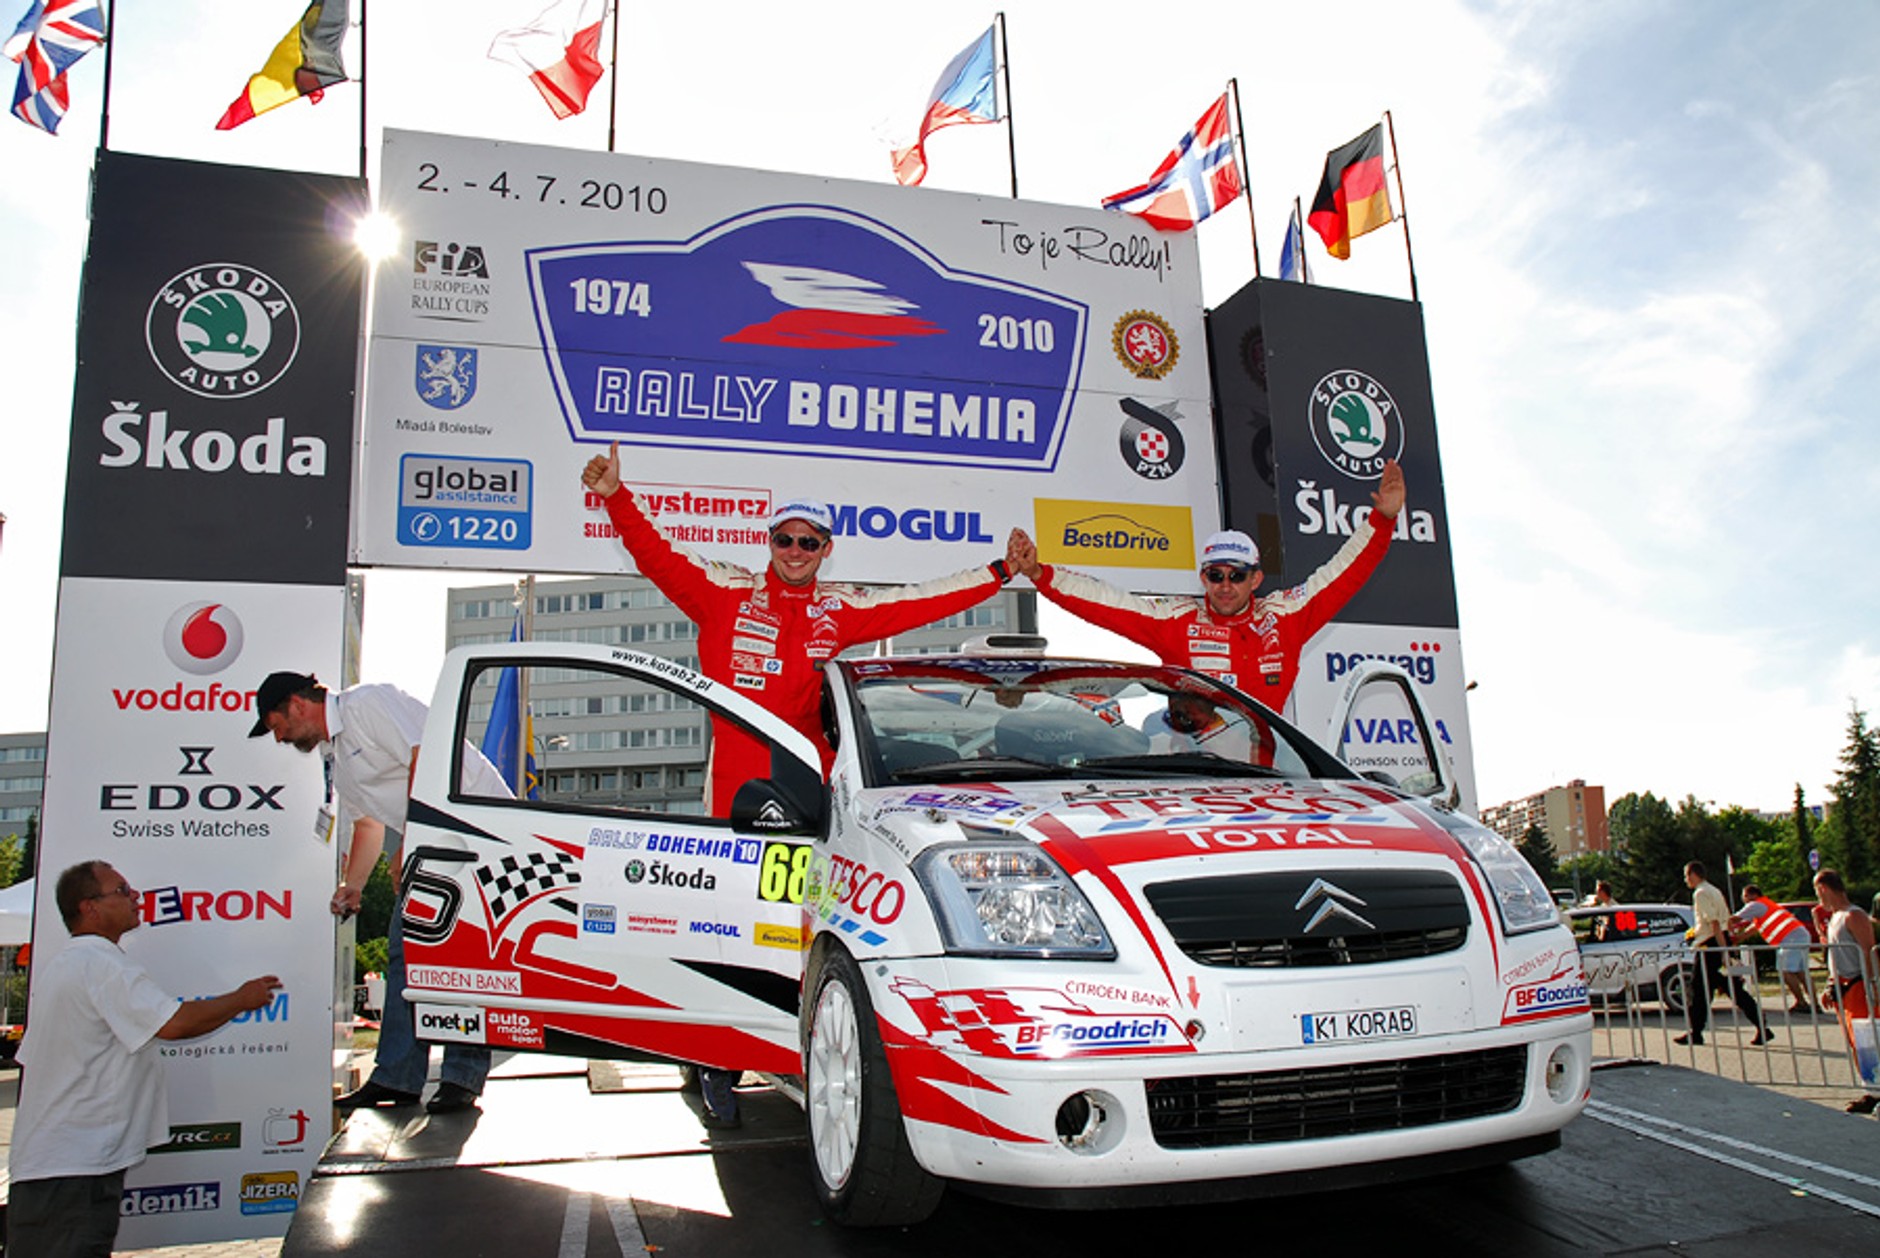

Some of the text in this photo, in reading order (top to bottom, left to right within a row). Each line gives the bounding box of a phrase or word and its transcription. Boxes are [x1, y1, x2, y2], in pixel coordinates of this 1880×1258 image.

[417, 163, 449, 193] 2.
[488, 171, 520, 200] 4.
[536, 174, 566, 204] 7.
[580, 180, 668, 215] 2010
[981, 219, 1172, 283] To je Rally!
[413, 279, 490, 296] EUROPEAN
[570, 277, 651, 318] 1974
[411, 295, 489, 315] RALLY CUPS
[978, 313, 1055, 353] 2010
[179, 366, 261, 392] AUTO
[595, 366, 1037, 444] RALLY BOHEMIA
[100, 401, 327, 478] Škoda
[395, 418, 493, 436] Mladá Boleslav
[1136, 460, 1173, 479] PZM
[1335, 452, 1385, 474] AUTO
[415, 466, 517, 500] global
[436, 490, 518, 505] assistance
[448, 516, 518, 542] 1220
[825, 503, 994, 544] MOGUL
[1063, 528, 1170, 552] BestDrive
[112, 681, 259, 712] vodafon
[1349, 756, 1399, 767] JOHNSON
[100, 784, 286, 811] EDOX
[1067, 794, 1374, 820] TESCO
[112, 819, 270, 838] Swiss Watches
[1168, 827, 1374, 850] TOTAL
[588, 827, 646, 847] RALLY
[646, 834, 733, 858] BOHEMIA
[648, 860, 717, 890] Škoda
[759, 843, 812, 904] 68
[831, 853, 906, 925] TESCO
[689, 920, 742, 938] MOGUL
[476, 973, 519, 992] BANK
[1131, 991, 1172, 1009] BANK
[421, 1012, 480, 1035] onet.pl
[489, 1012, 531, 1027] auto
[497, 1025, 539, 1035] motor
[1016, 1018, 1168, 1045] BFGoodrich
[1315, 1009, 1414, 1039] K1 KORAB
[120, 1186, 217, 1216] deník
[239, 1183, 298, 1199] JIZERA
